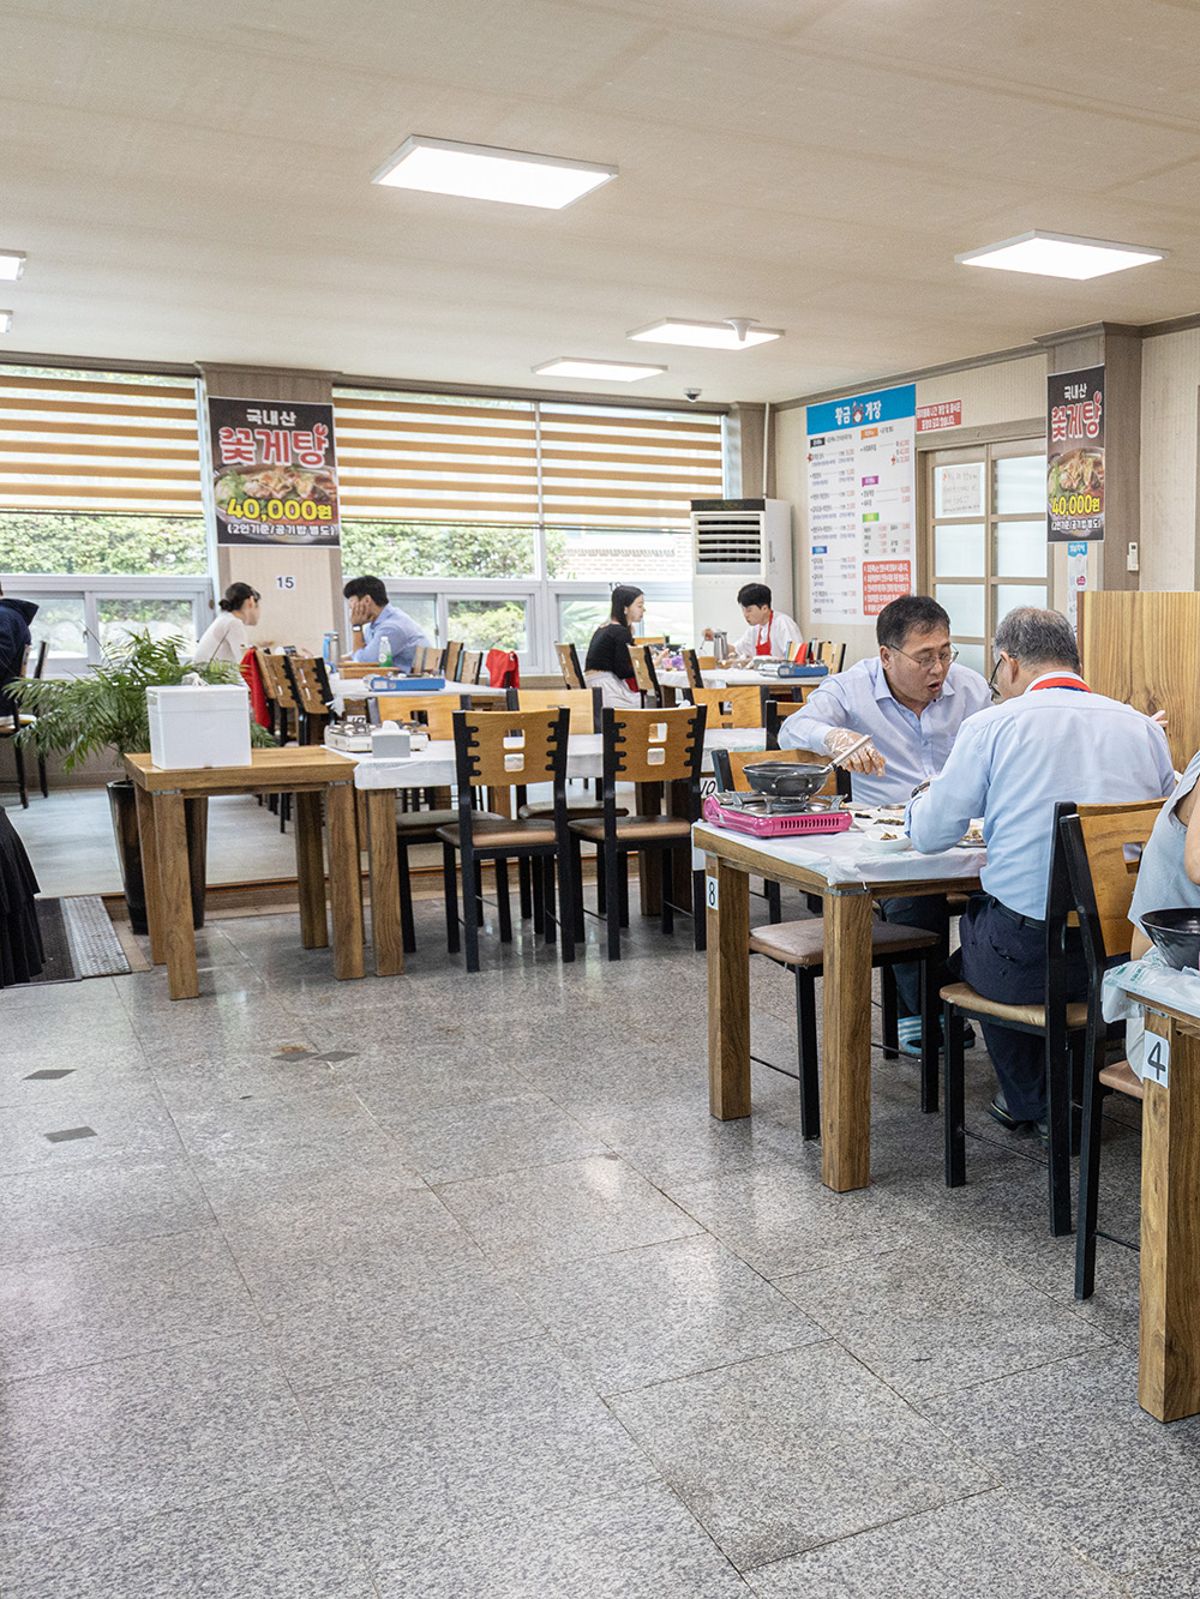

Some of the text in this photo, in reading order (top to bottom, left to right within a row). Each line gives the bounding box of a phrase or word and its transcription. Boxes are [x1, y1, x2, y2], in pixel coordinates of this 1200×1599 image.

[246, 409, 297, 427] 국내산
[1051, 391, 1102, 442] 꽃게탕
[219, 423, 329, 468] 꽃게탕
[227, 499, 333, 522] 40,000원
[277, 577, 294, 588] 15
[709, 881, 715, 906] 8
[1147, 1041, 1166, 1080] 4
